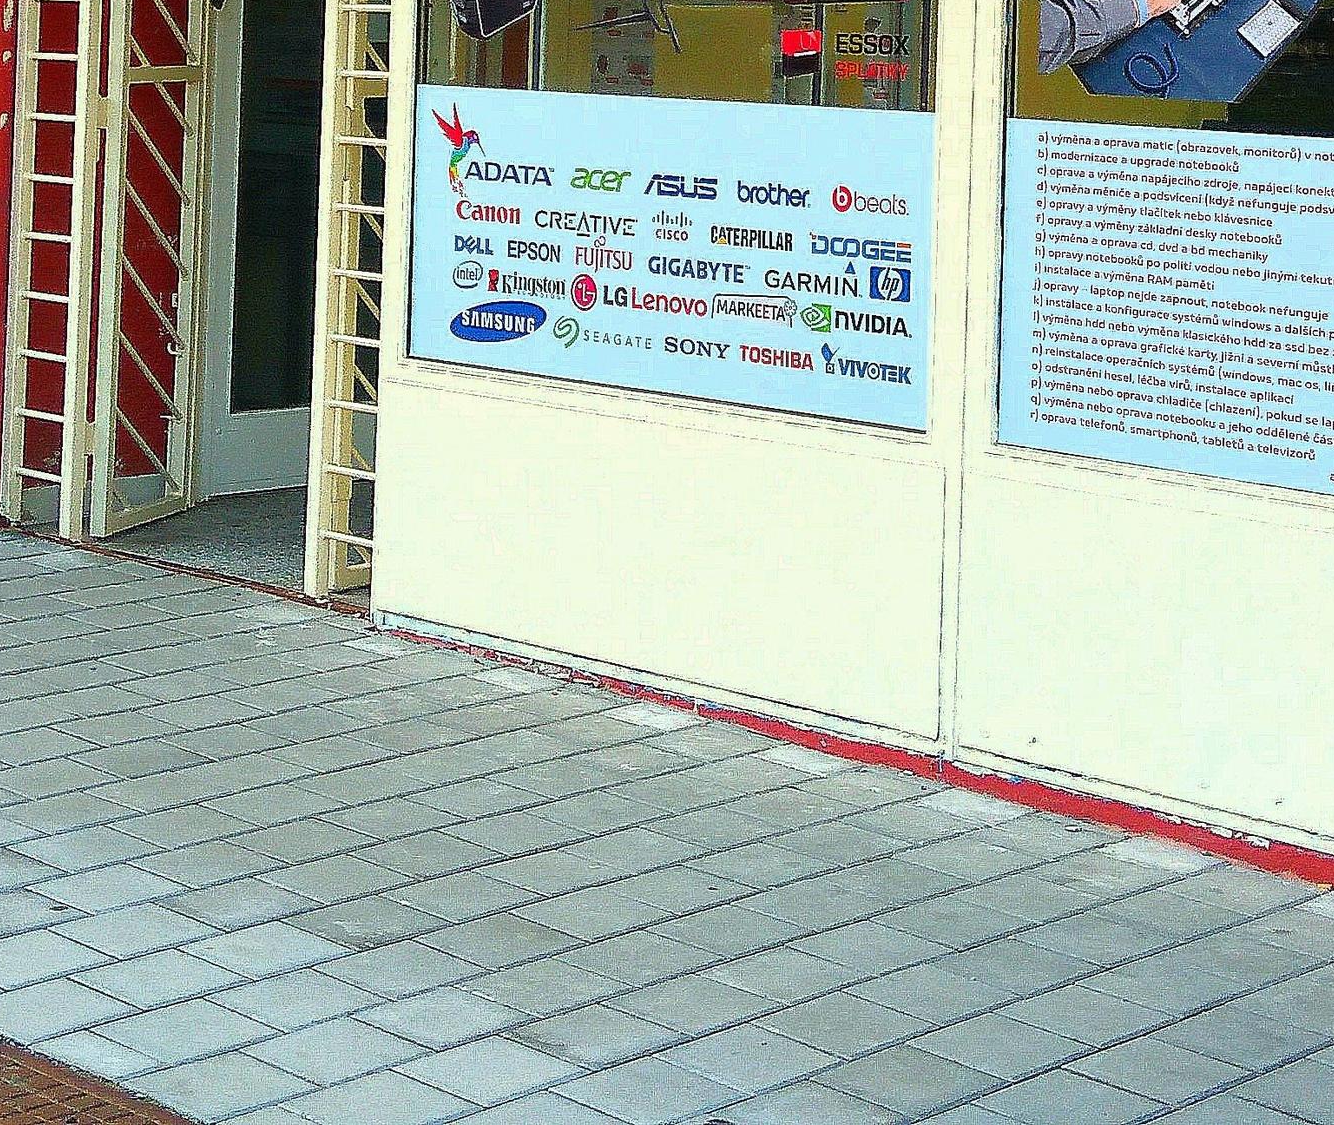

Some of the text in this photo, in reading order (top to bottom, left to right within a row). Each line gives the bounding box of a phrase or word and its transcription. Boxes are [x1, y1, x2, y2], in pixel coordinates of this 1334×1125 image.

[836, 33, 910, 56] ESSOX
[1050, 133, 1092, 146] výměna
[1103, 139, 1140, 149] oprava
[1142, 141, 1174, 151] matic
[1176, 139, 1241, 157] (obrazovek,
[1243, 147, 1302, 163] monitorů)
[1051, 150, 1118, 164] modernizace
[1130, 157, 1176, 169] upgrade
[1178, 160, 1240, 173] notebooků
[464, 161, 552, 187] ADATA
[570, 167, 632, 193] acer
[643, 174, 718, 200] ASUS
[737, 180, 810, 208] brother
[1049, 168, 1086, 179] oprava
[1097, 169, 1139, 182] výměna
[1141, 174, 1201, 188] napájecího
[1203, 178, 1241, 192] zdroje,
[1244, 181, 1293, 196] napájecí
[1050, 182, 1091, 195] výměna
[1092, 186, 1132, 198] měniče
[1142, 191, 1203, 204] podsvícení
[1204, 193, 1235, 209] (když
[1237, 198, 1297, 214] nefunguje
[1049, 200, 1085, 214] opravy
[1096, 203, 1137, 218] výměny
[1139, 206, 1182, 219] tlačítek
[1183, 210, 1212, 222] nebo
[1214, 212, 1273, 228] klávesnice
[456, 200, 521, 225] Canon
[534, 209, 638, 238] CREATIVE
[710, 225, 793, 252] CATERPILLAR
[811, 232, 912, 264] DOOGEE
[454, 234, 900, 301] DELL EPSON FUJITSU GIGABYTE GARMIN hp
[456, 267, 478, 281] intel
[501, 271, 567, 297] Kingston
[603, 285, 628, 308] LG
[632, 287, 708, 317] Lenovo
[716, 299, 786, 322] MARKEETA
[461, 309, 912, 385] SAMSUNG SEAGATE SONY TOSHIBA VIVOTEK
